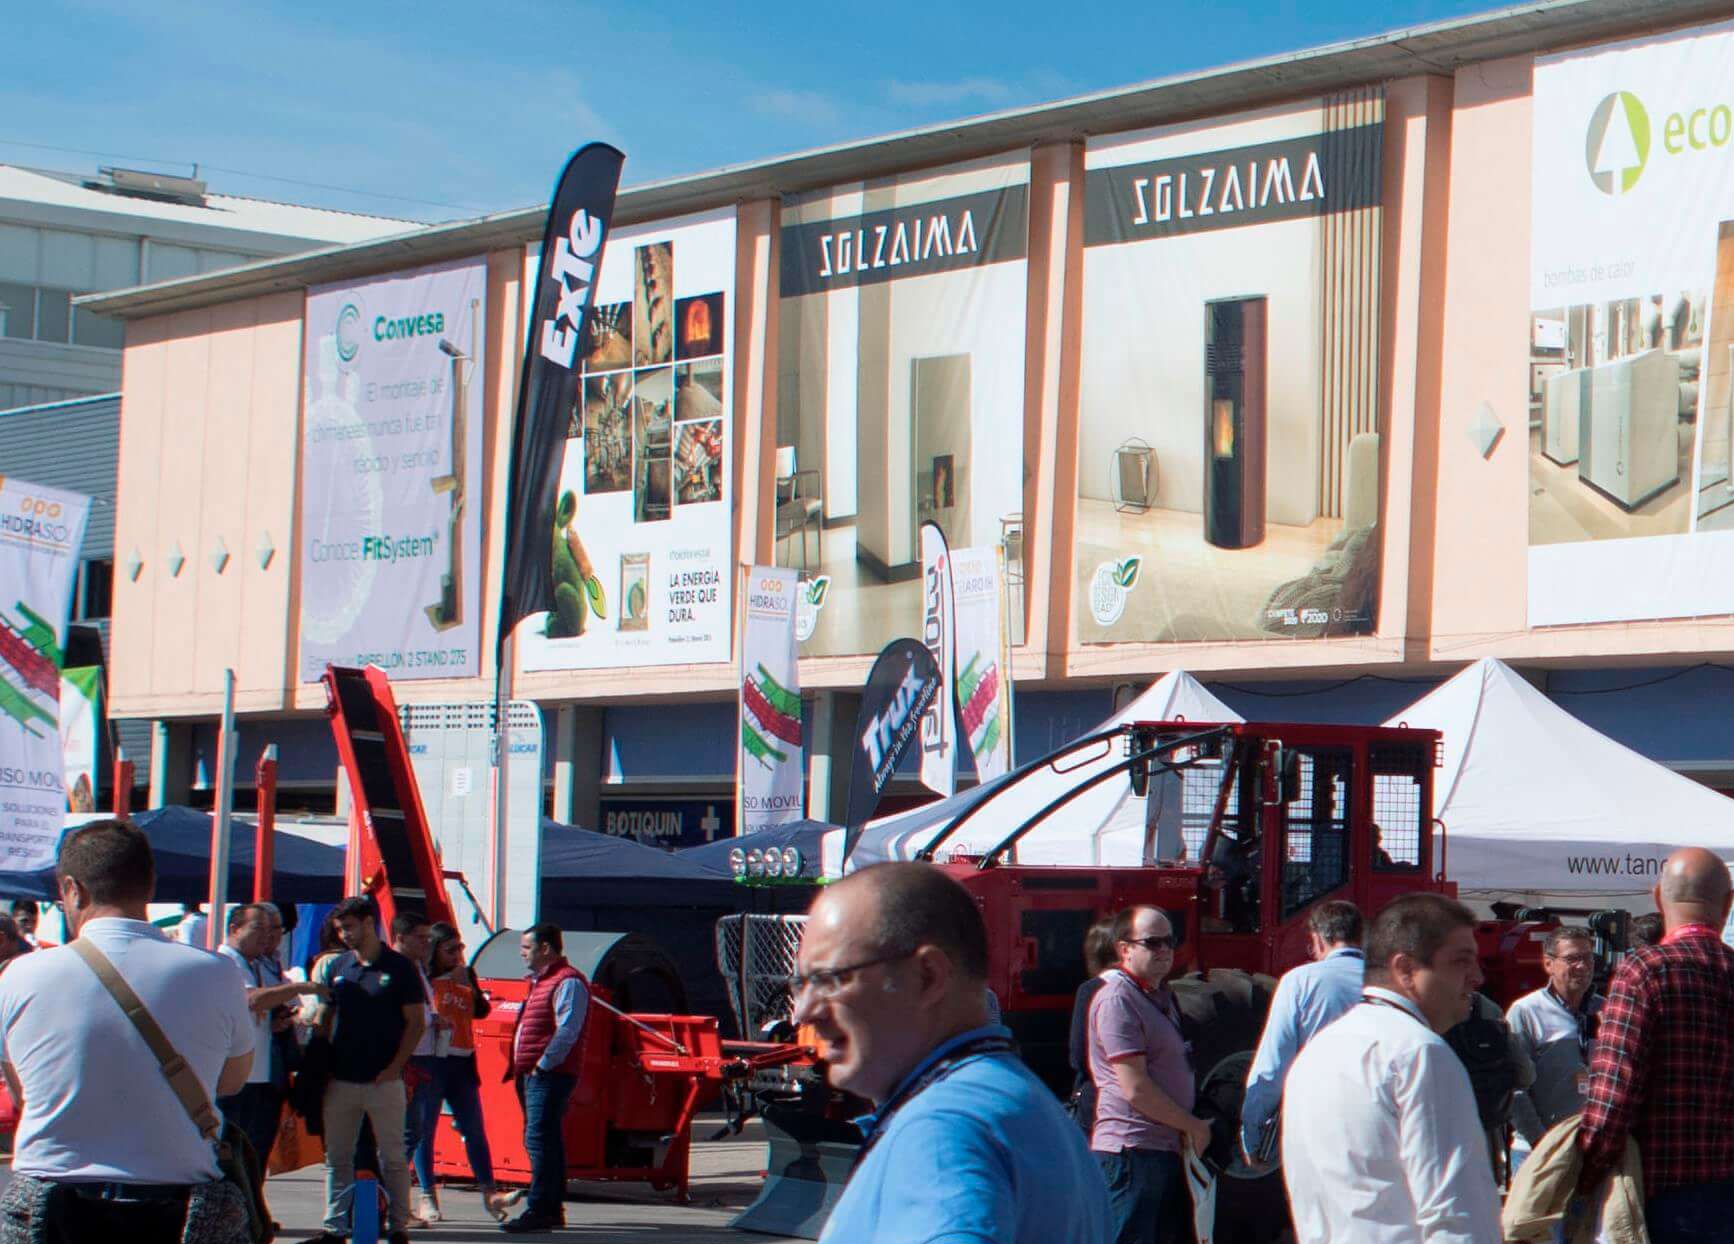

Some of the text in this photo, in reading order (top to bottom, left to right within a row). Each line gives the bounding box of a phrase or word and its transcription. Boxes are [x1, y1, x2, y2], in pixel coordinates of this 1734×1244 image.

[1134, 151, 1325, 225] SOLZAIMA
[820, 208, 978, 277] SOLZAIMA
[541, 208, 603, 368] ExTe
[1590, 264, 1605, 281] de
[373, 312, 444, 341] Convesa
[607, 811, 682, 836] BOTIQUIN
